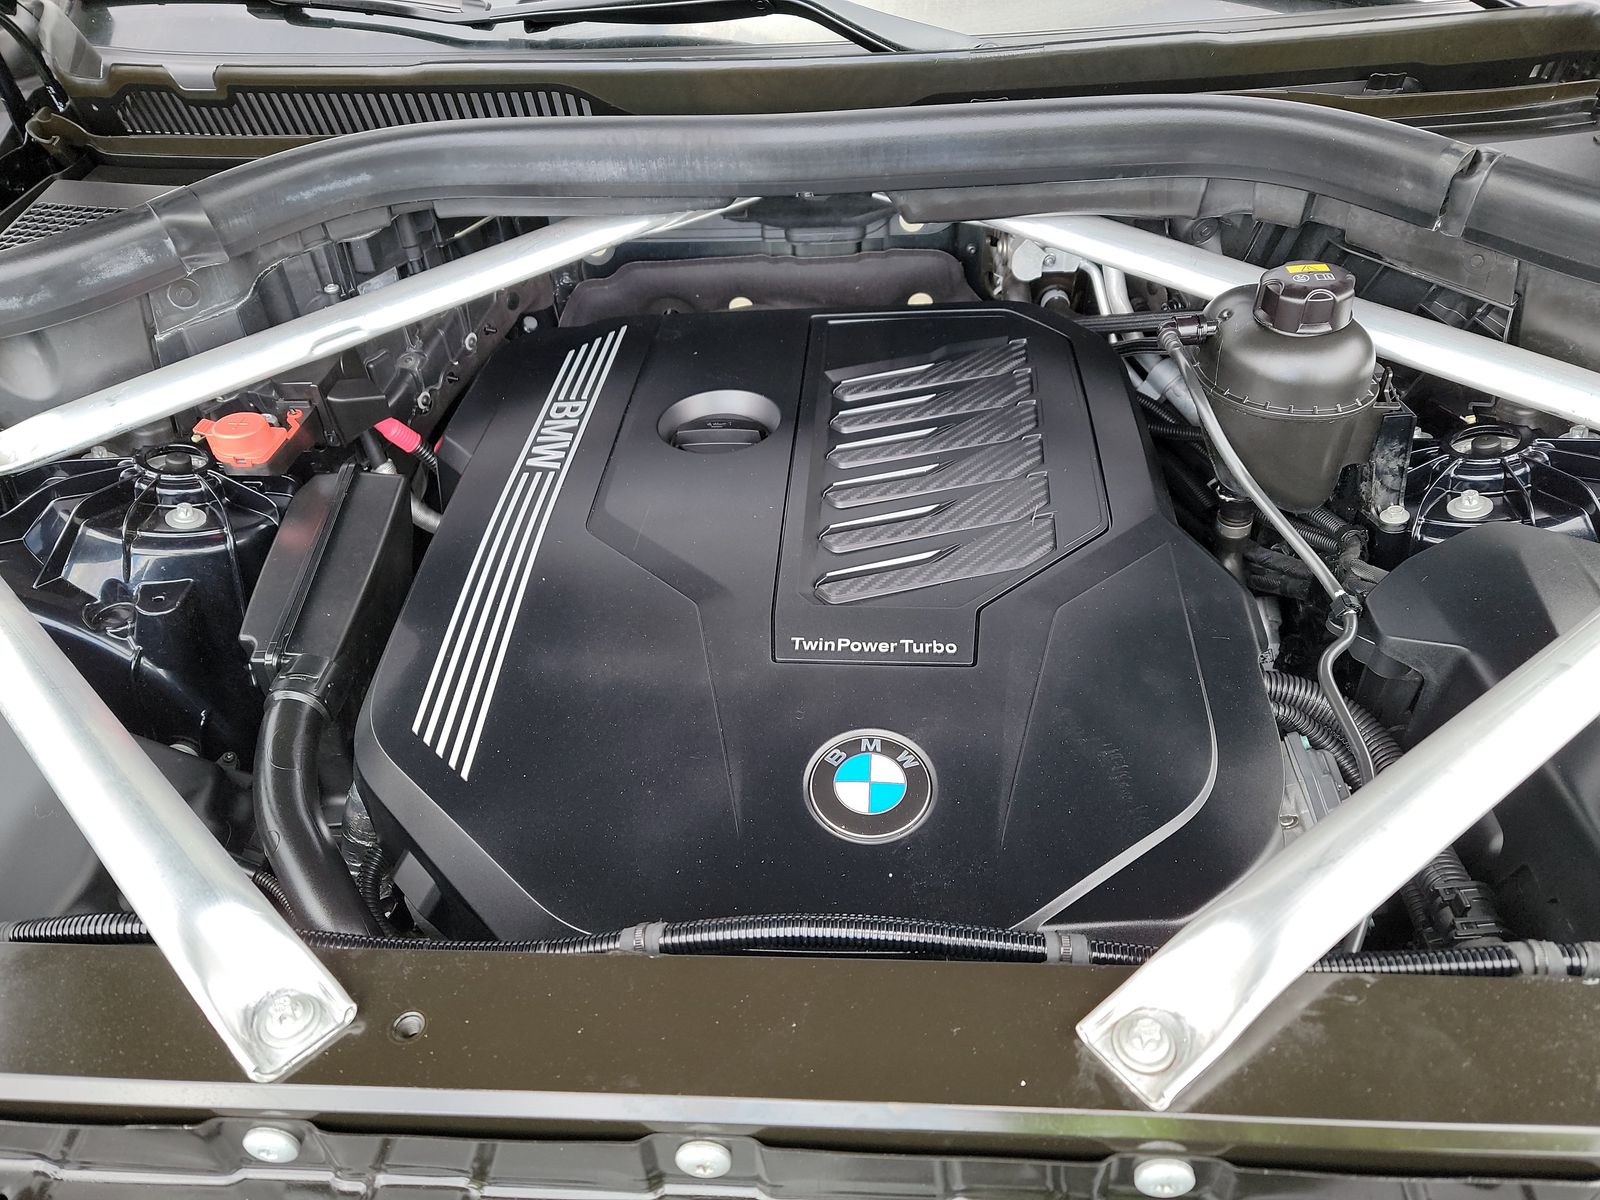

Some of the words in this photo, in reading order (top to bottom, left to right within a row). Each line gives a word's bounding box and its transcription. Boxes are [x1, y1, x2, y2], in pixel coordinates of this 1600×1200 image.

[525, 400, 588, 470] BMW
[790, 637, 898, 653] TwinPower
[899, 639, 958, 654] Turbo
